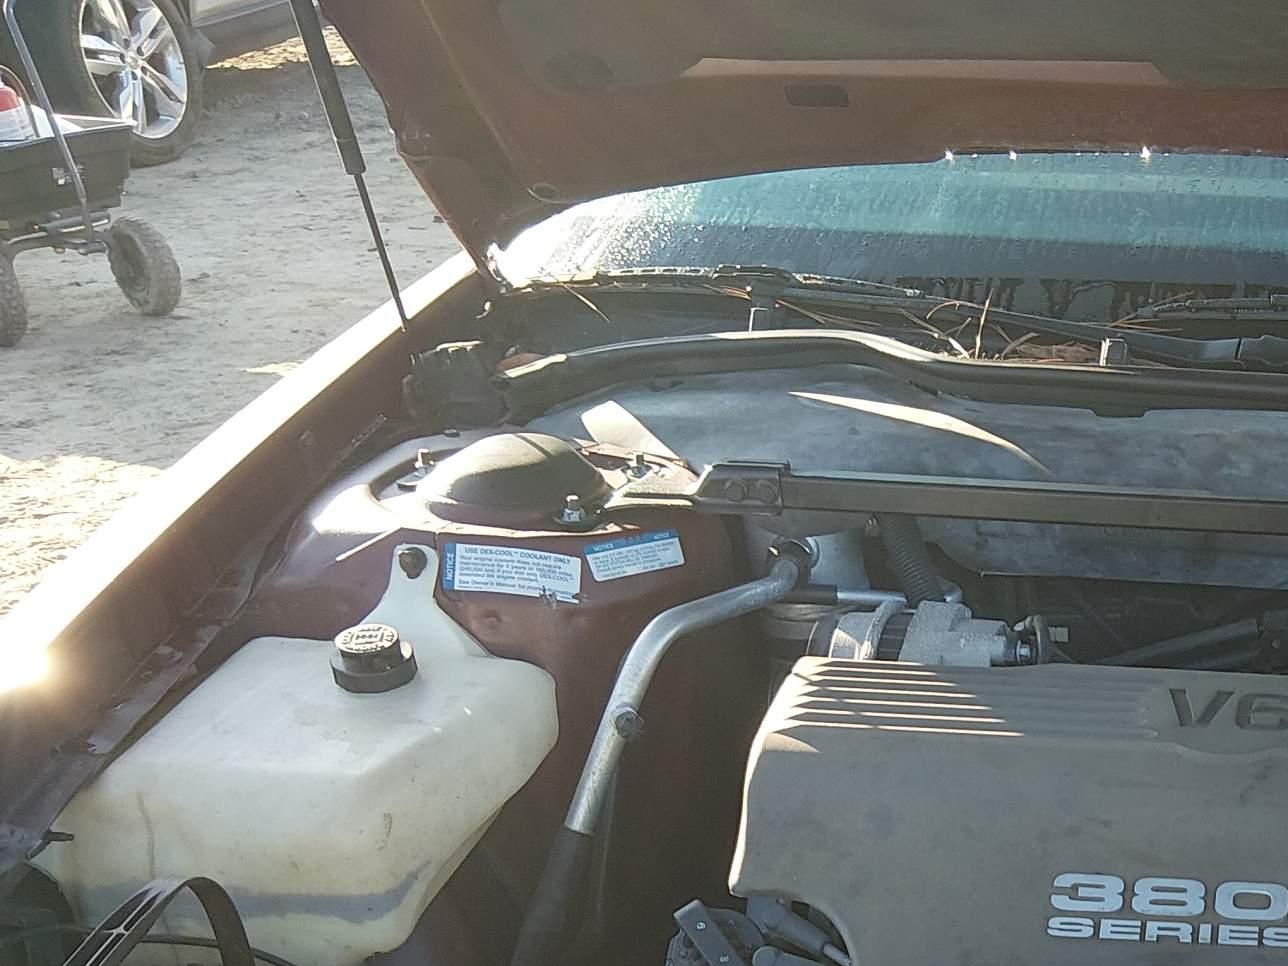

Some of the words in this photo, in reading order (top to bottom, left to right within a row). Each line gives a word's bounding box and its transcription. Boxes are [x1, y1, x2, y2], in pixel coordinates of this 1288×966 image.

[446, 551, 455, 581] NOTICE
[465, 546, 478, 554] USE
[520, 552, 552, 561] COOLANT
[554, 556, 571, 564] ONLY
